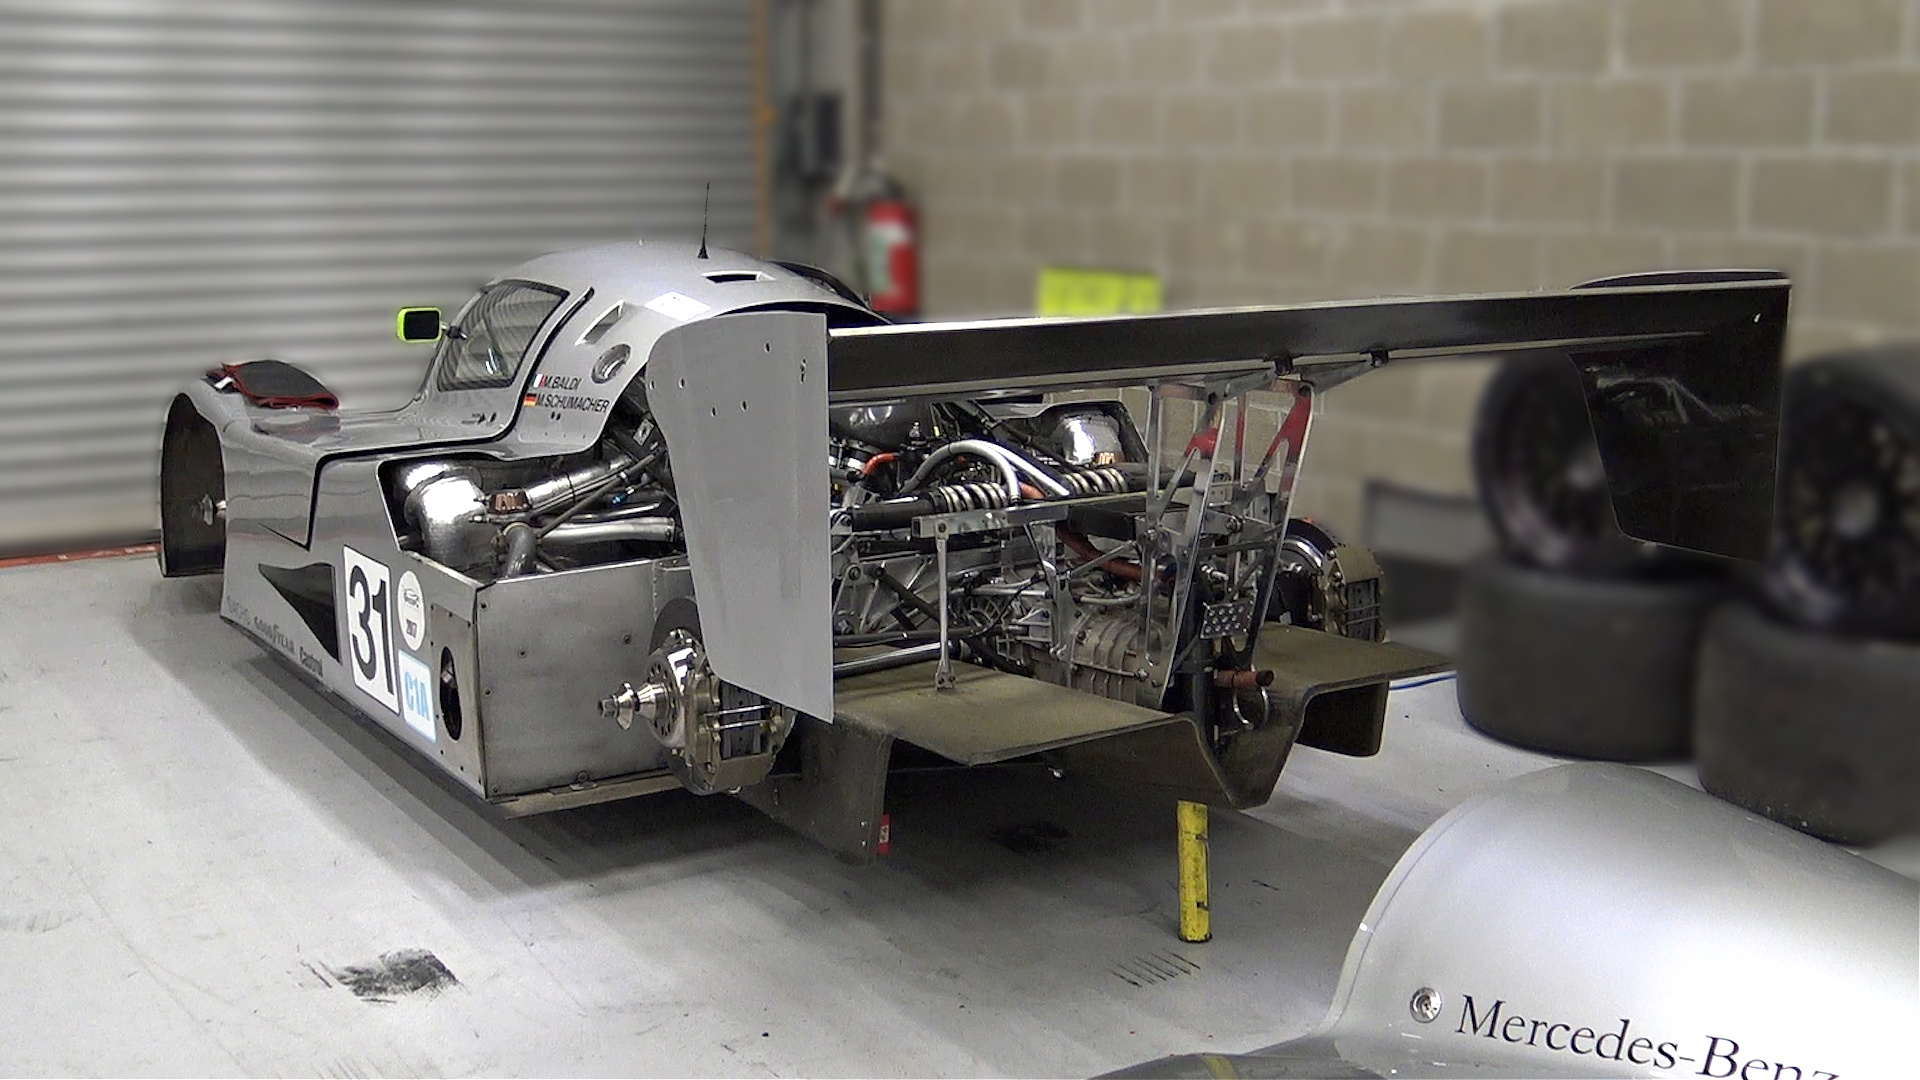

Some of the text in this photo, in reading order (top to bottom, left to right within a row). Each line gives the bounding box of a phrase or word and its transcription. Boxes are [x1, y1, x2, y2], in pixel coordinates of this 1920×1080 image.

[543, 375, 582, 391] M.BALDI
[536, 393, 610, 412] M.SCHUMACHER
[350, 564, 394, 696] 31
